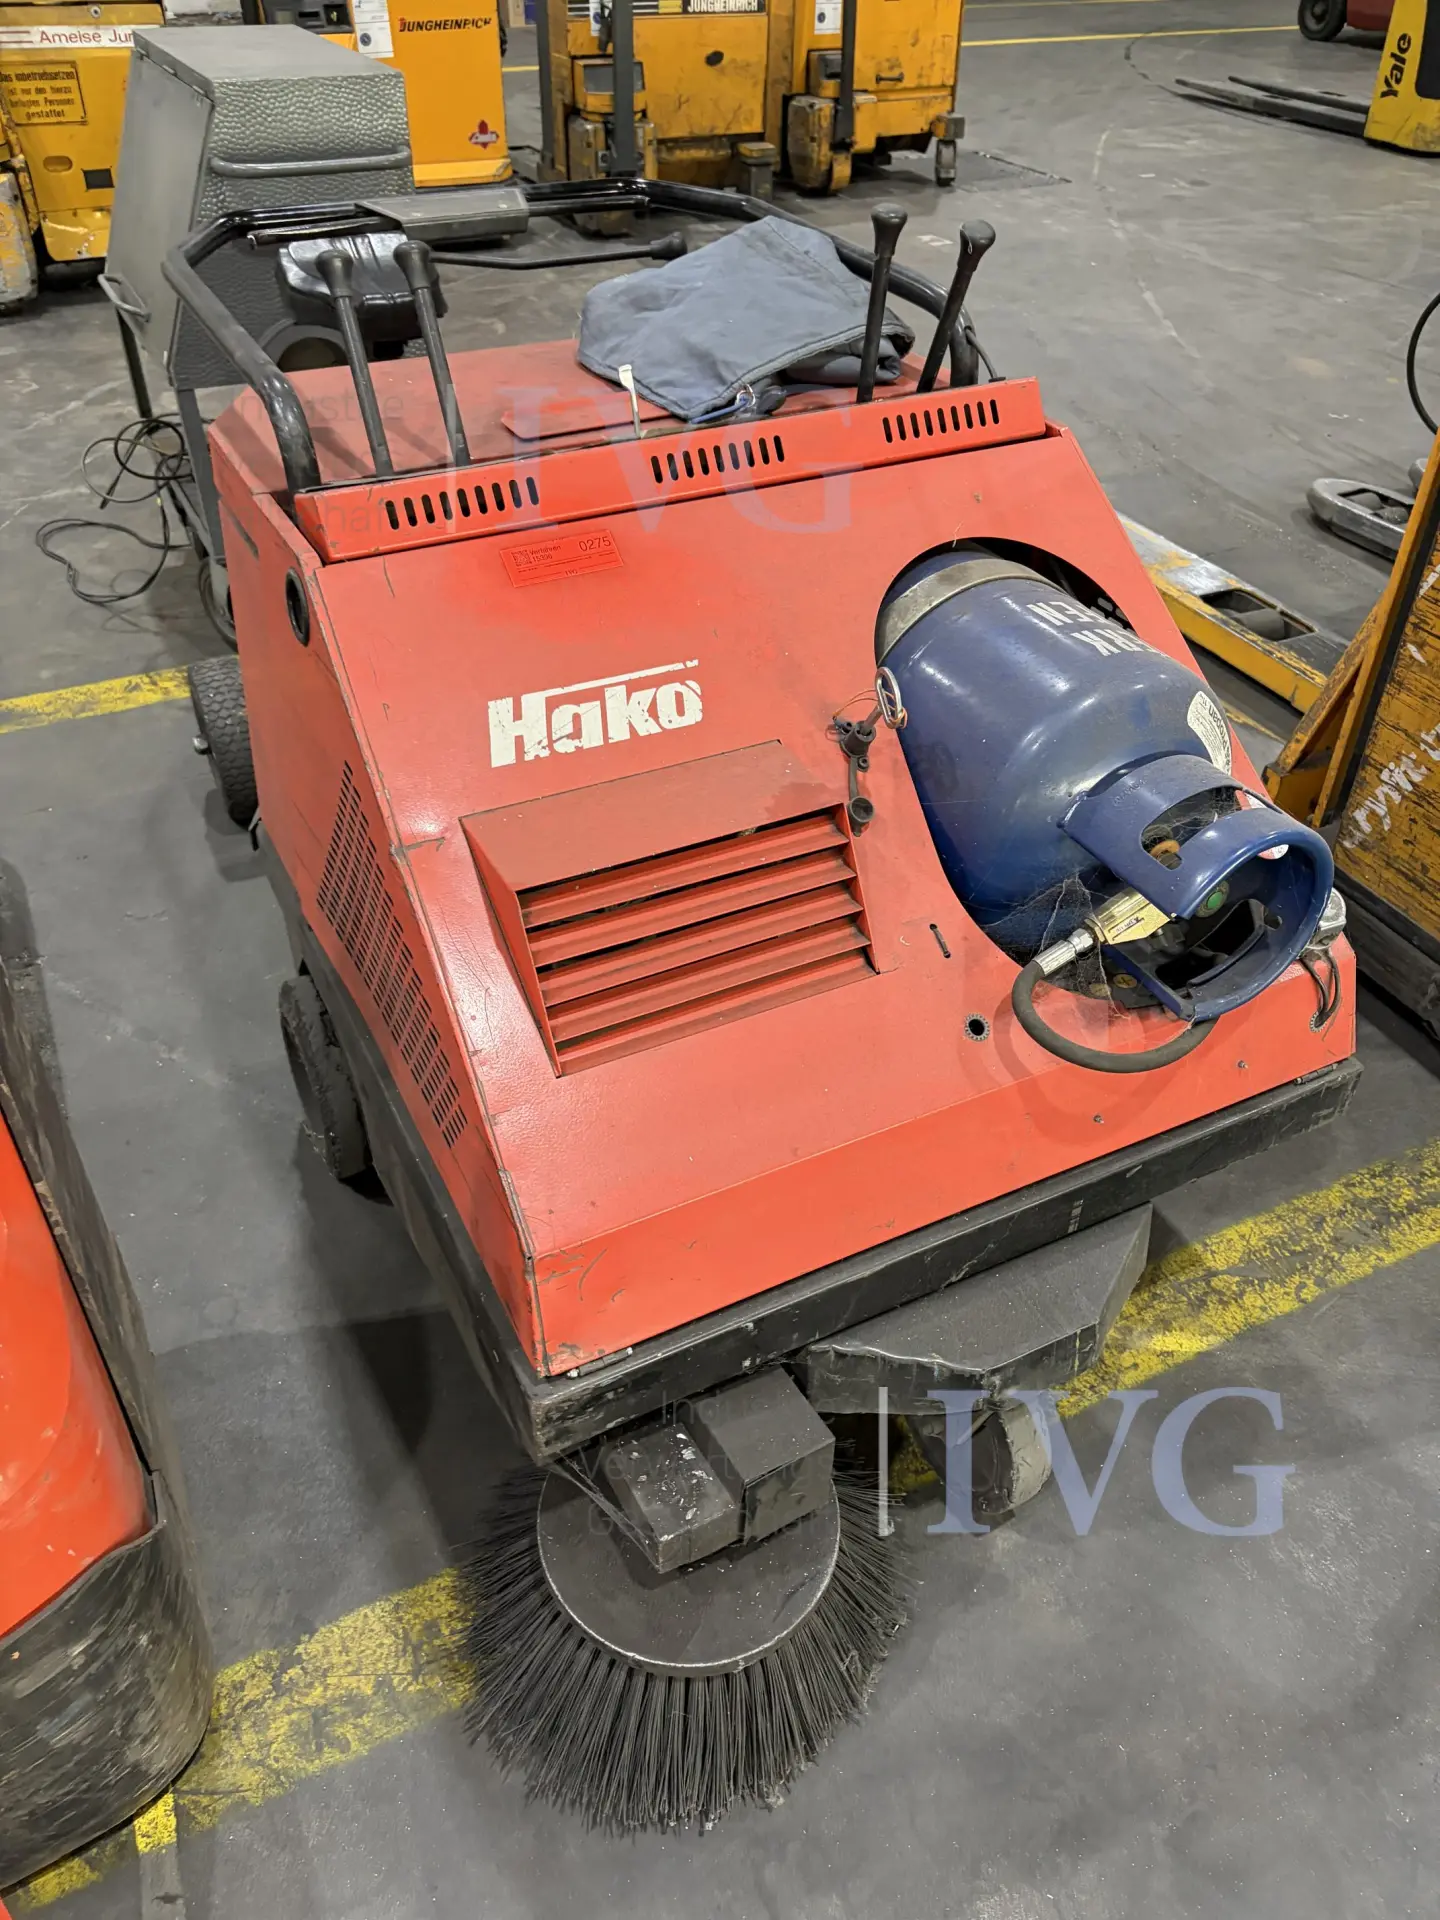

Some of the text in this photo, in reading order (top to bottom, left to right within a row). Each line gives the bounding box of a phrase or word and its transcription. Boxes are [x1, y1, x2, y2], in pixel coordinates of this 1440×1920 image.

[1380, 33, 1412, 98] Yale
[579, 536, 612, 552] 0275
[488, 662, 704, 769] Hako
